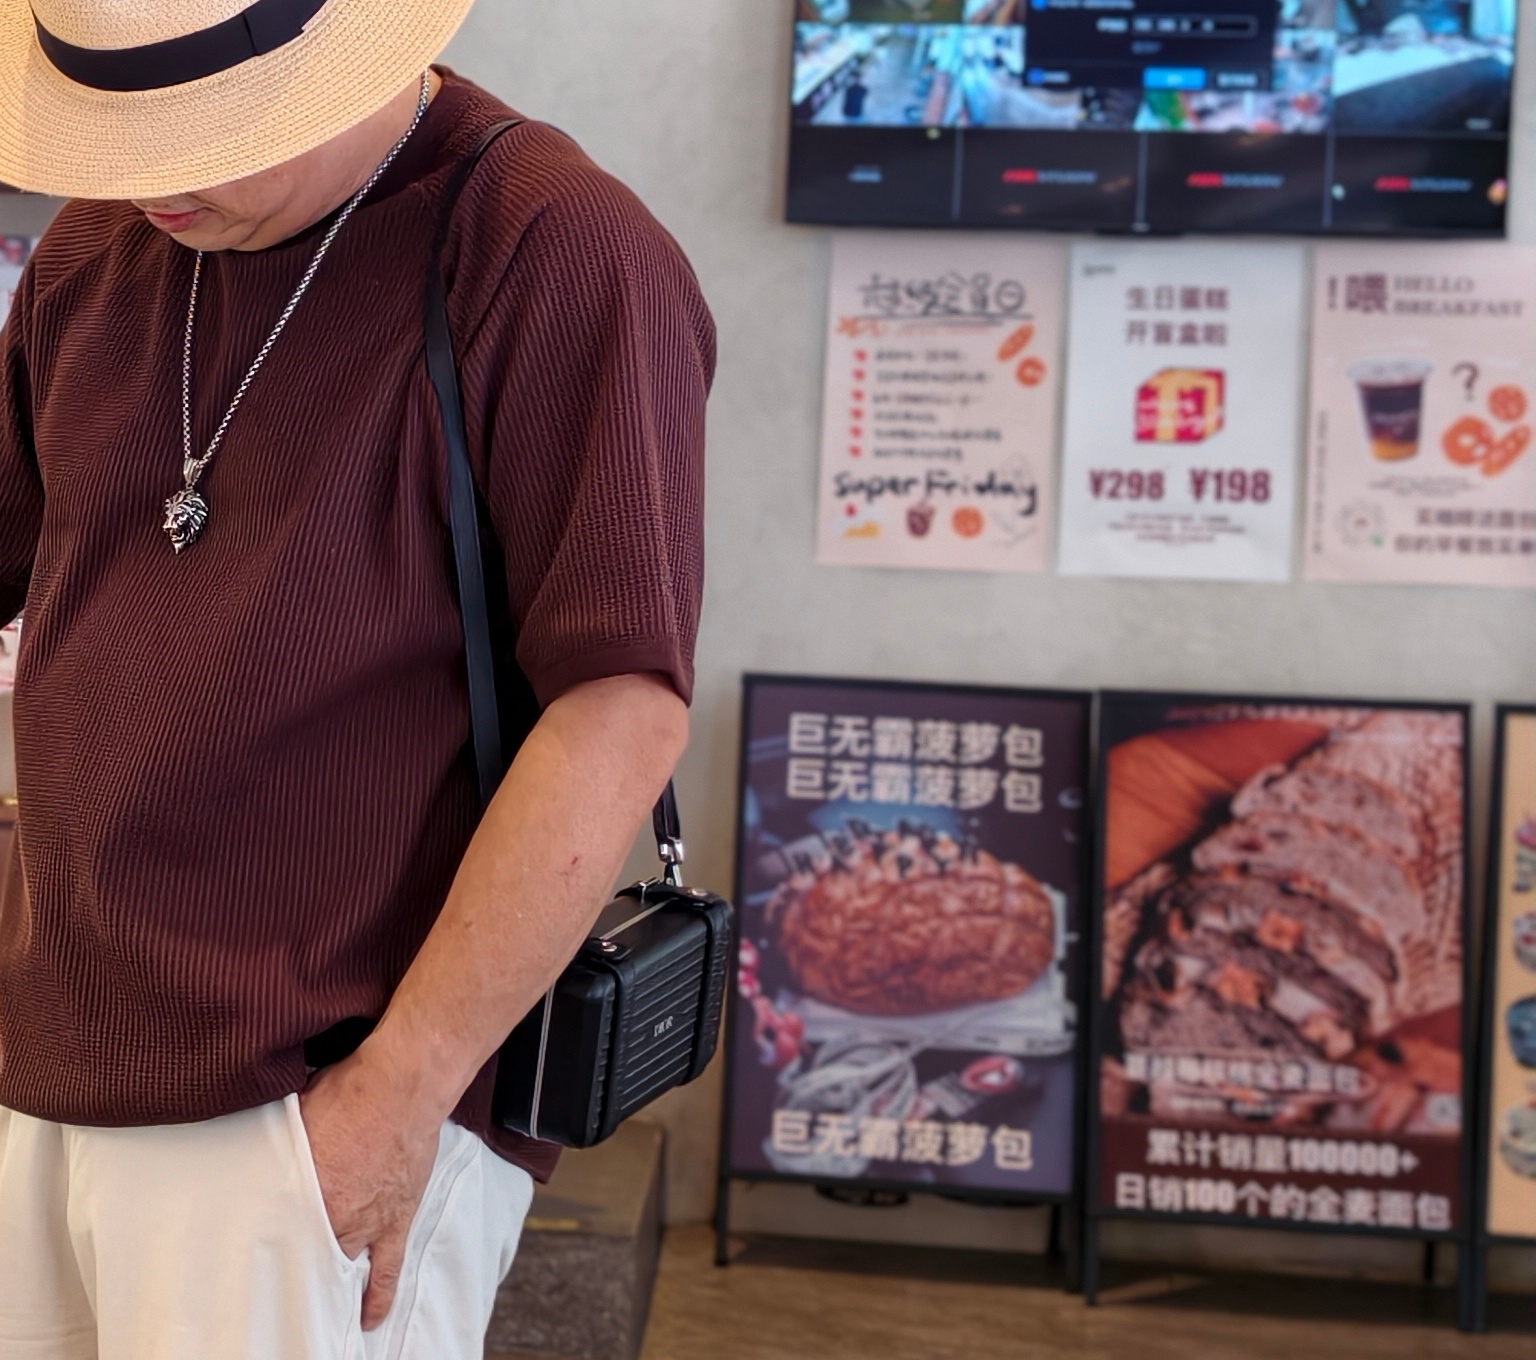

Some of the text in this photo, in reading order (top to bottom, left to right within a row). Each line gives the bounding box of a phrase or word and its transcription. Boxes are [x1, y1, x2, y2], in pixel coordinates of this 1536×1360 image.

[1126, 286, 1229, 311] 生日蛋糕
[1088, 469, 1272, 504] ¥298 ¥198
[789, 712, 1044, 768] 巨无霸菠萝包
[786, 758, 1044, 813] 巨无霸菠萝包
[772, 1110, 1034, 1172] 巨无霸菠萝包
